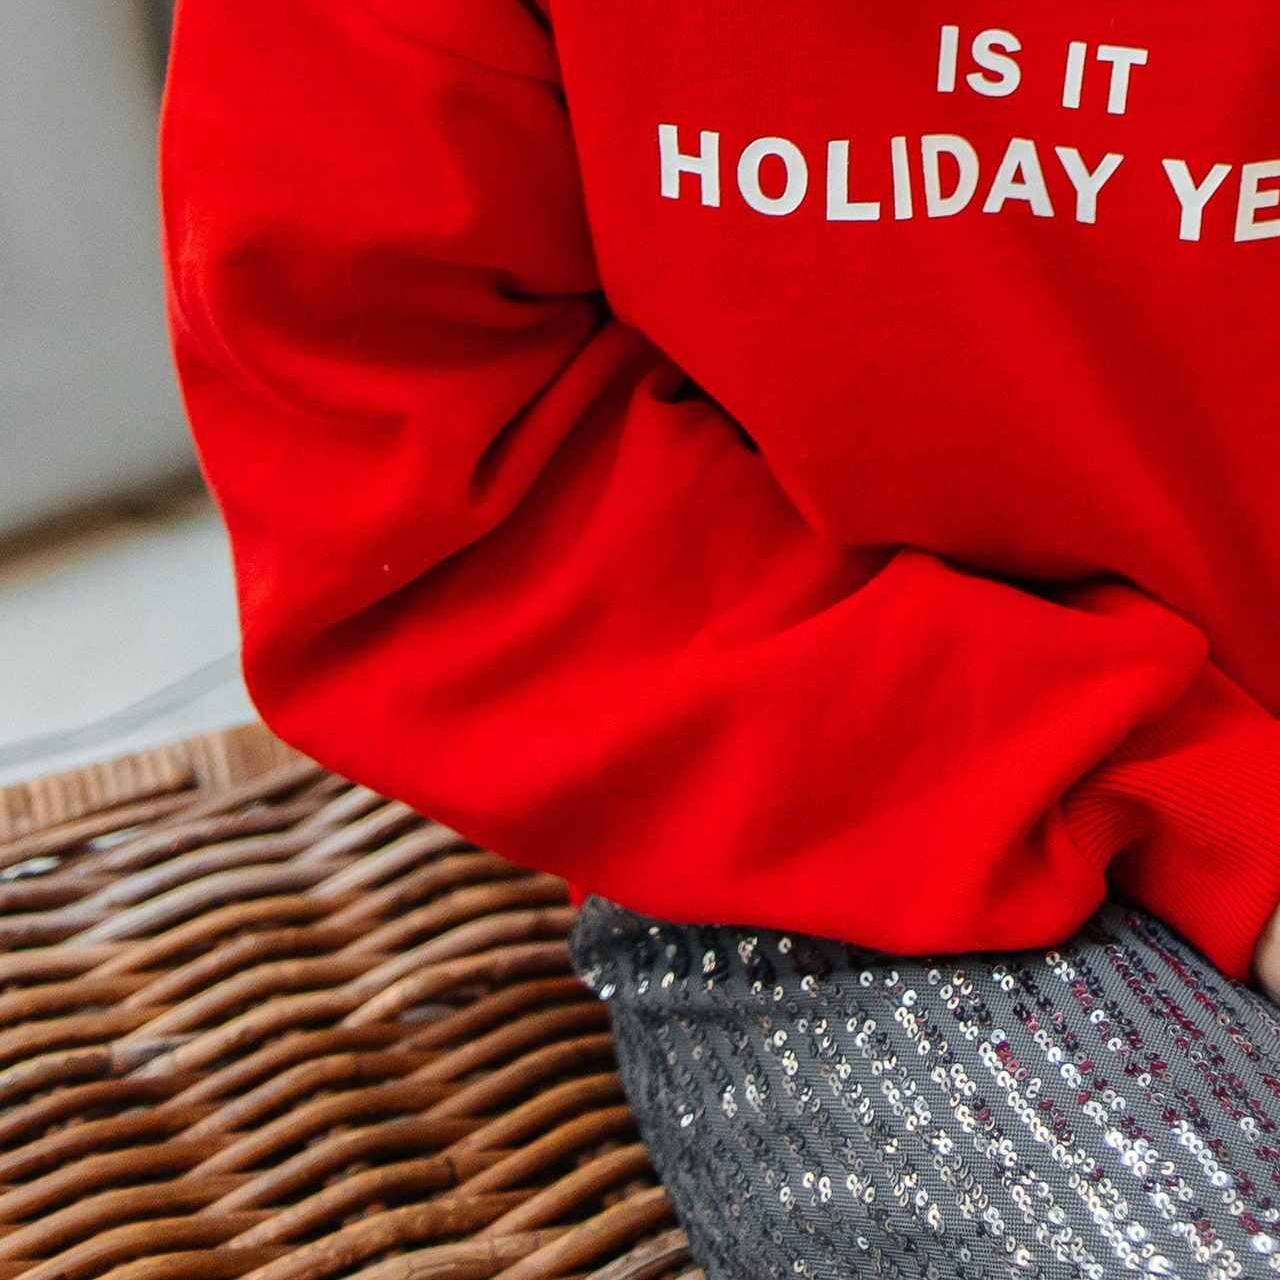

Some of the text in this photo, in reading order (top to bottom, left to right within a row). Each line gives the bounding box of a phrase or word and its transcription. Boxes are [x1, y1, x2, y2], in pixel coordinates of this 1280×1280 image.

[937, 25, 1149, 115] IS IT
[658, 124, 1124, 224] HOLIDAY
